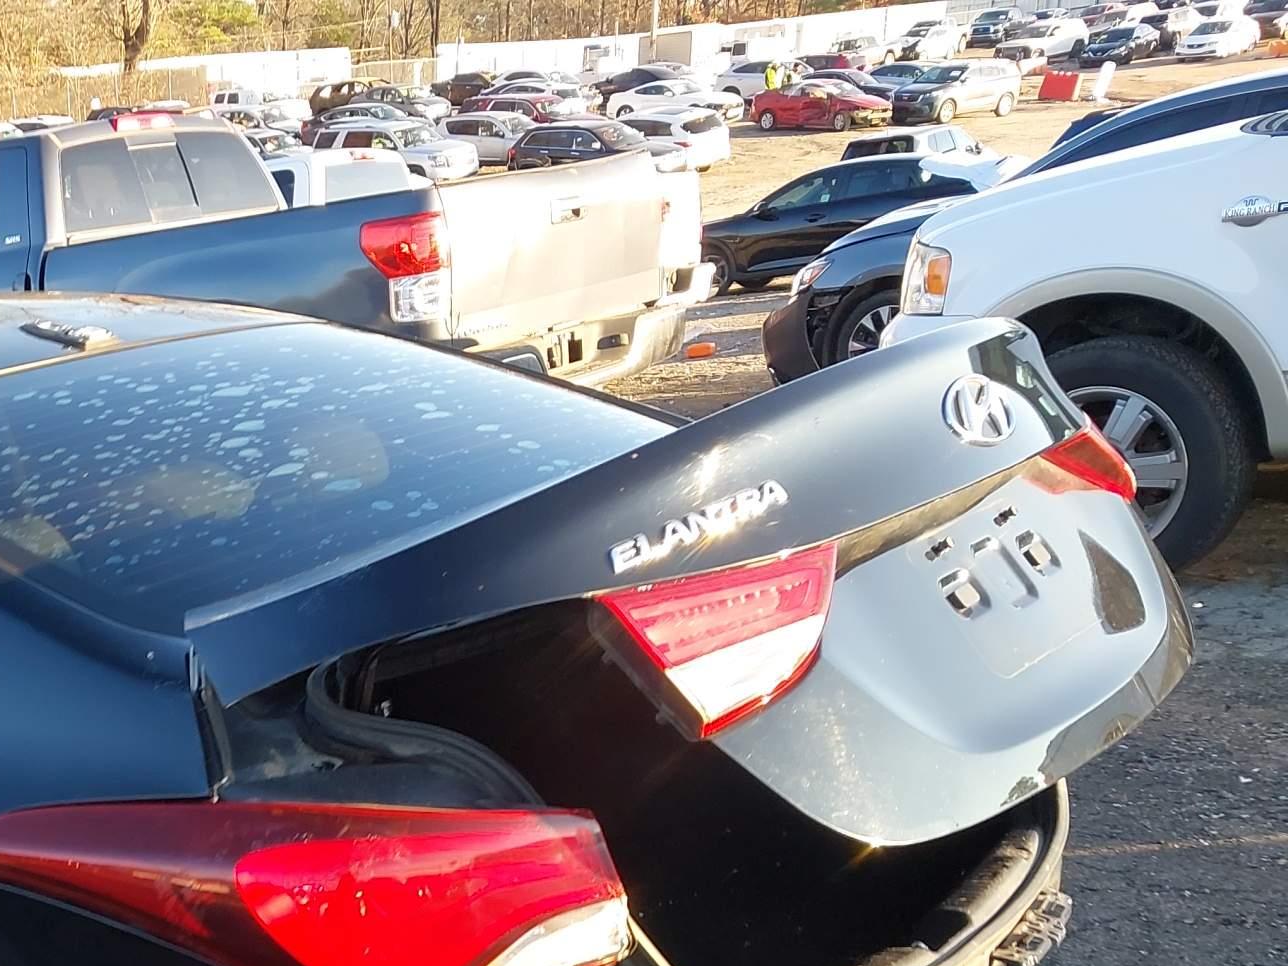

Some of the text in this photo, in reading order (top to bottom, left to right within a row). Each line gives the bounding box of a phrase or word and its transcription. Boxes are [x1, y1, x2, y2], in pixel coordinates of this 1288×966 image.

[1222, 207, 1245, 219] KING
[1246, 202, 1277, 216] RANCH
[610, 479, 790, 575] ELANTRA
